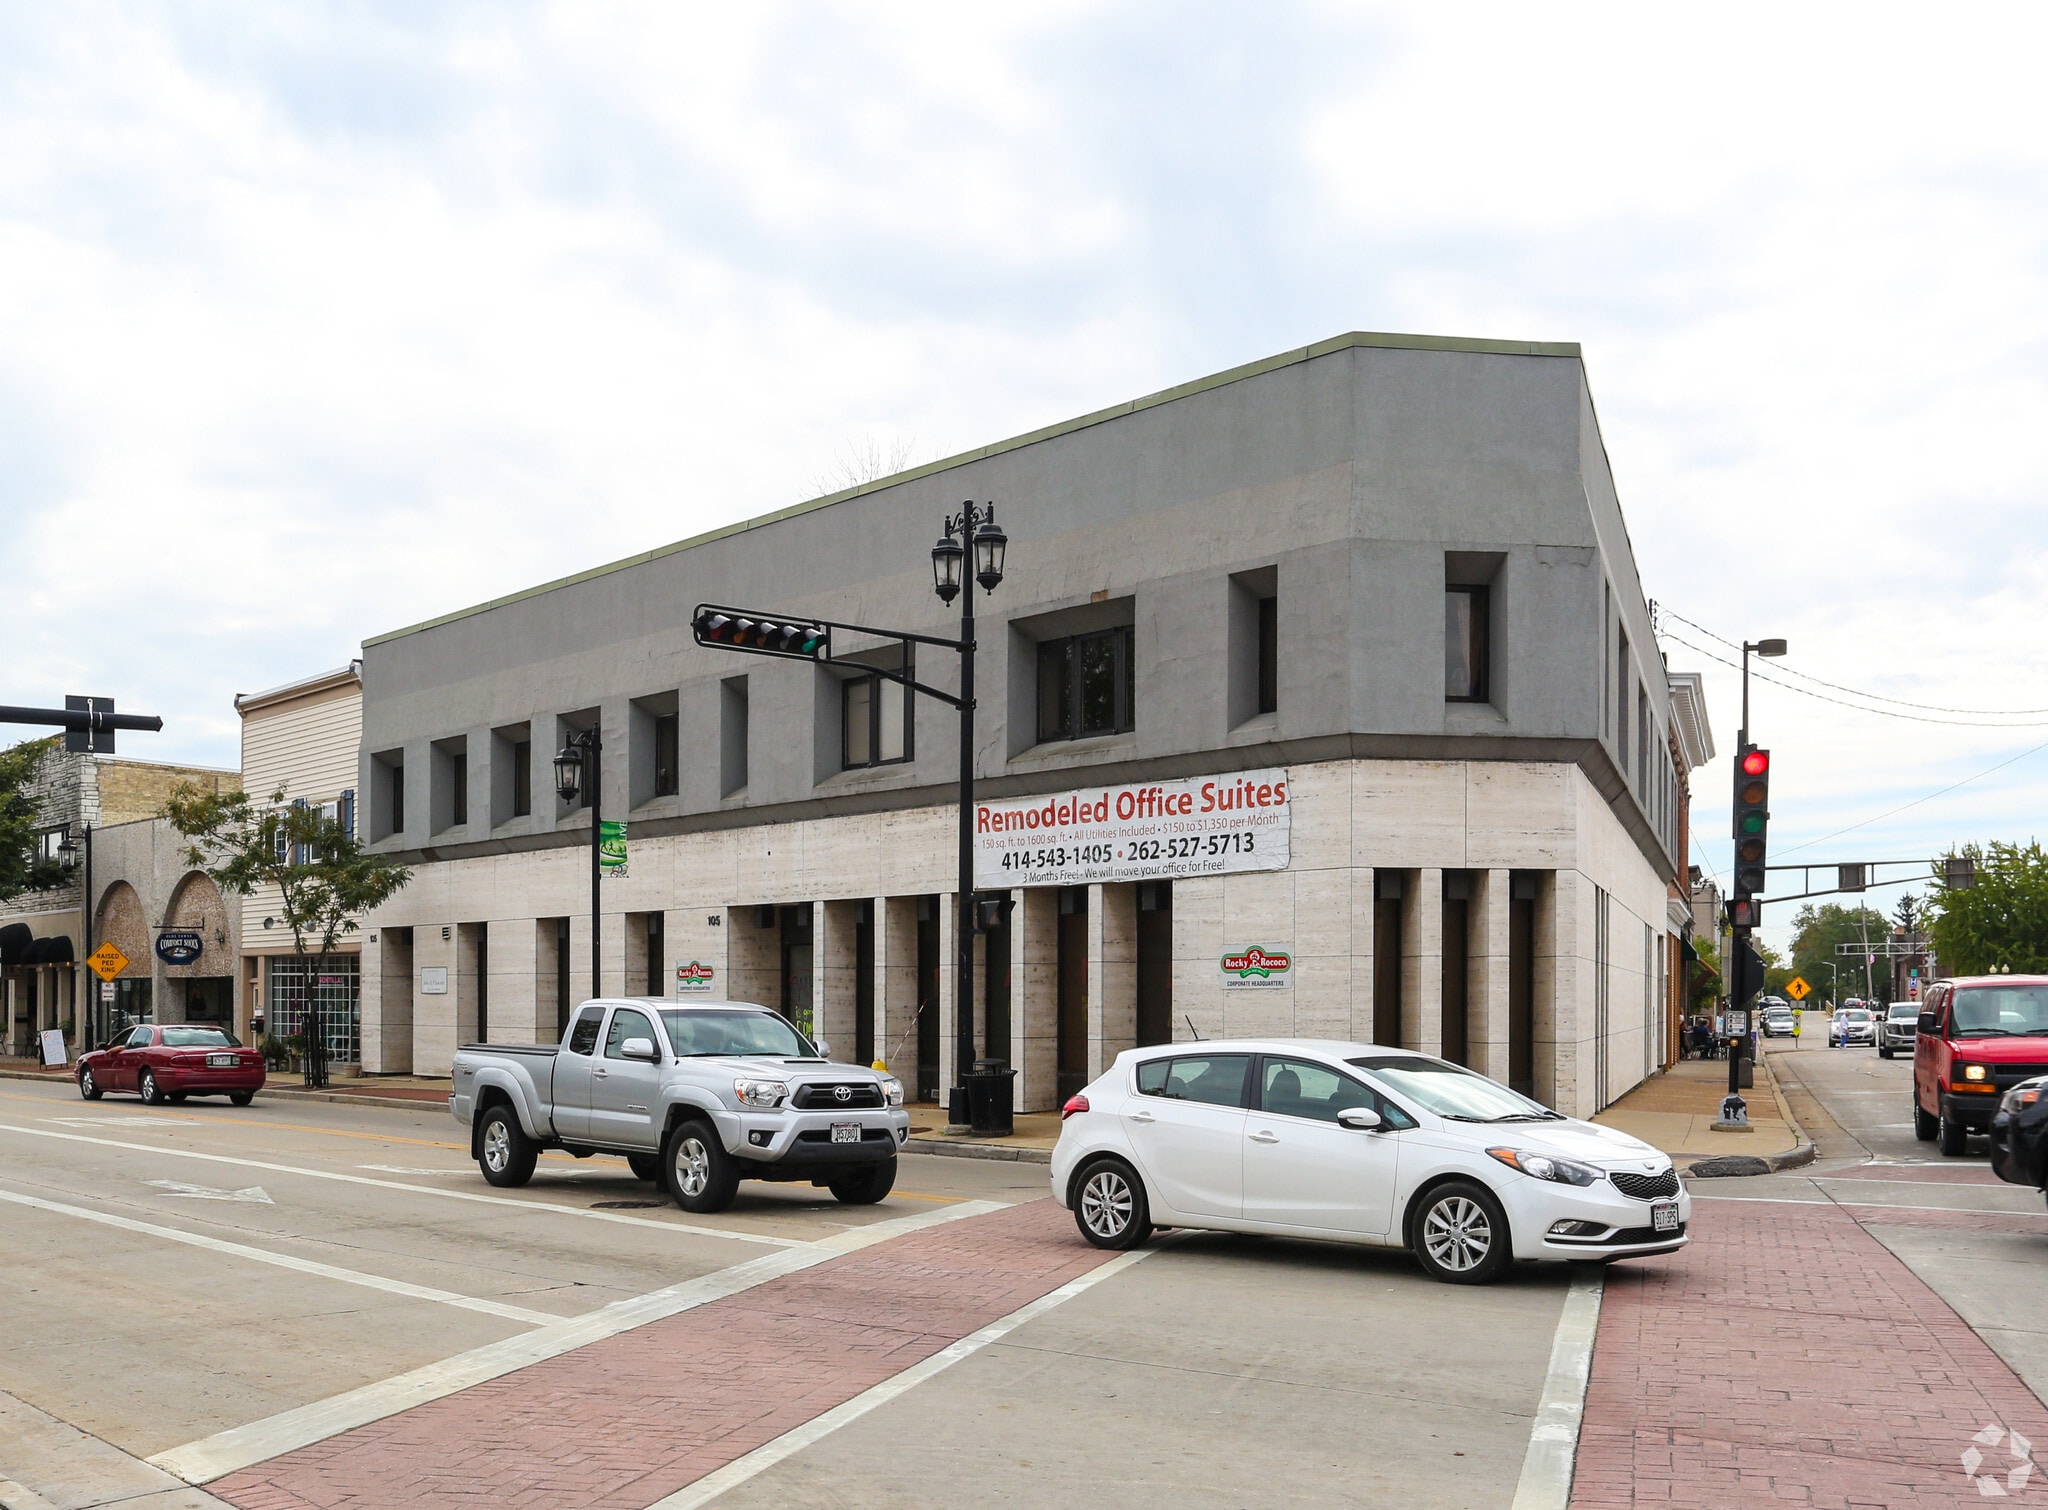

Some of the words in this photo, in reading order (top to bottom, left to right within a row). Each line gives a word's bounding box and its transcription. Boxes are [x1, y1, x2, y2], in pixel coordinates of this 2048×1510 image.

[977, 792, 1109, 833] Remodeled
[1116, 787, 1193, 820] Office
[1200, 778, 1286, 812] Suites
[982, 839, 995, 849] 150
[996, 840, 1006, 850] sq.
[1008, 837, 1016, 847] ft.
[1017, 837, 1025, 846] to
[1027, 835, 1046, 846] 1600
[1047, 836, 1058, 847] sq.
[1059, 832, 1067, 842] ft.
[1073, 830, 1084, 841] All
[1085, 827, 1117, 840] Utilities
[1118, 823, 1155, 837] Included
[1163, 821, 1184, 834] $150
[1186, 822, 1195, 832] to
[1197, 817, 1228, 831] $1,350
[1229, 819, 1245, 831] per
[1247, 812, 1279, 826] Month
[1002, 843, 1113, 870] 414-543-1405
[1127, 832, 1255, 861] 262-527-5713
[1023, 873, 1028, 883] 3
[1029, 870, 1058, 883] Months
[1060, 869, 1079, 880] Free!
[1084, 868, 1098, 879] We
[1099, 866, 1113, 878] will
[1115, 866, 1139, 877] move
[1141, 863, 1161, 877] your
[1162, 861, 1187, 874] office
[1188, 860, 1202, 871] for
[1203, 858, 1225, 871] Free!
[707, 915, 721, 926] 105
[1225, 958, 1248, 969] Rocky
[1260, 957, 1287, 966] Rococo
